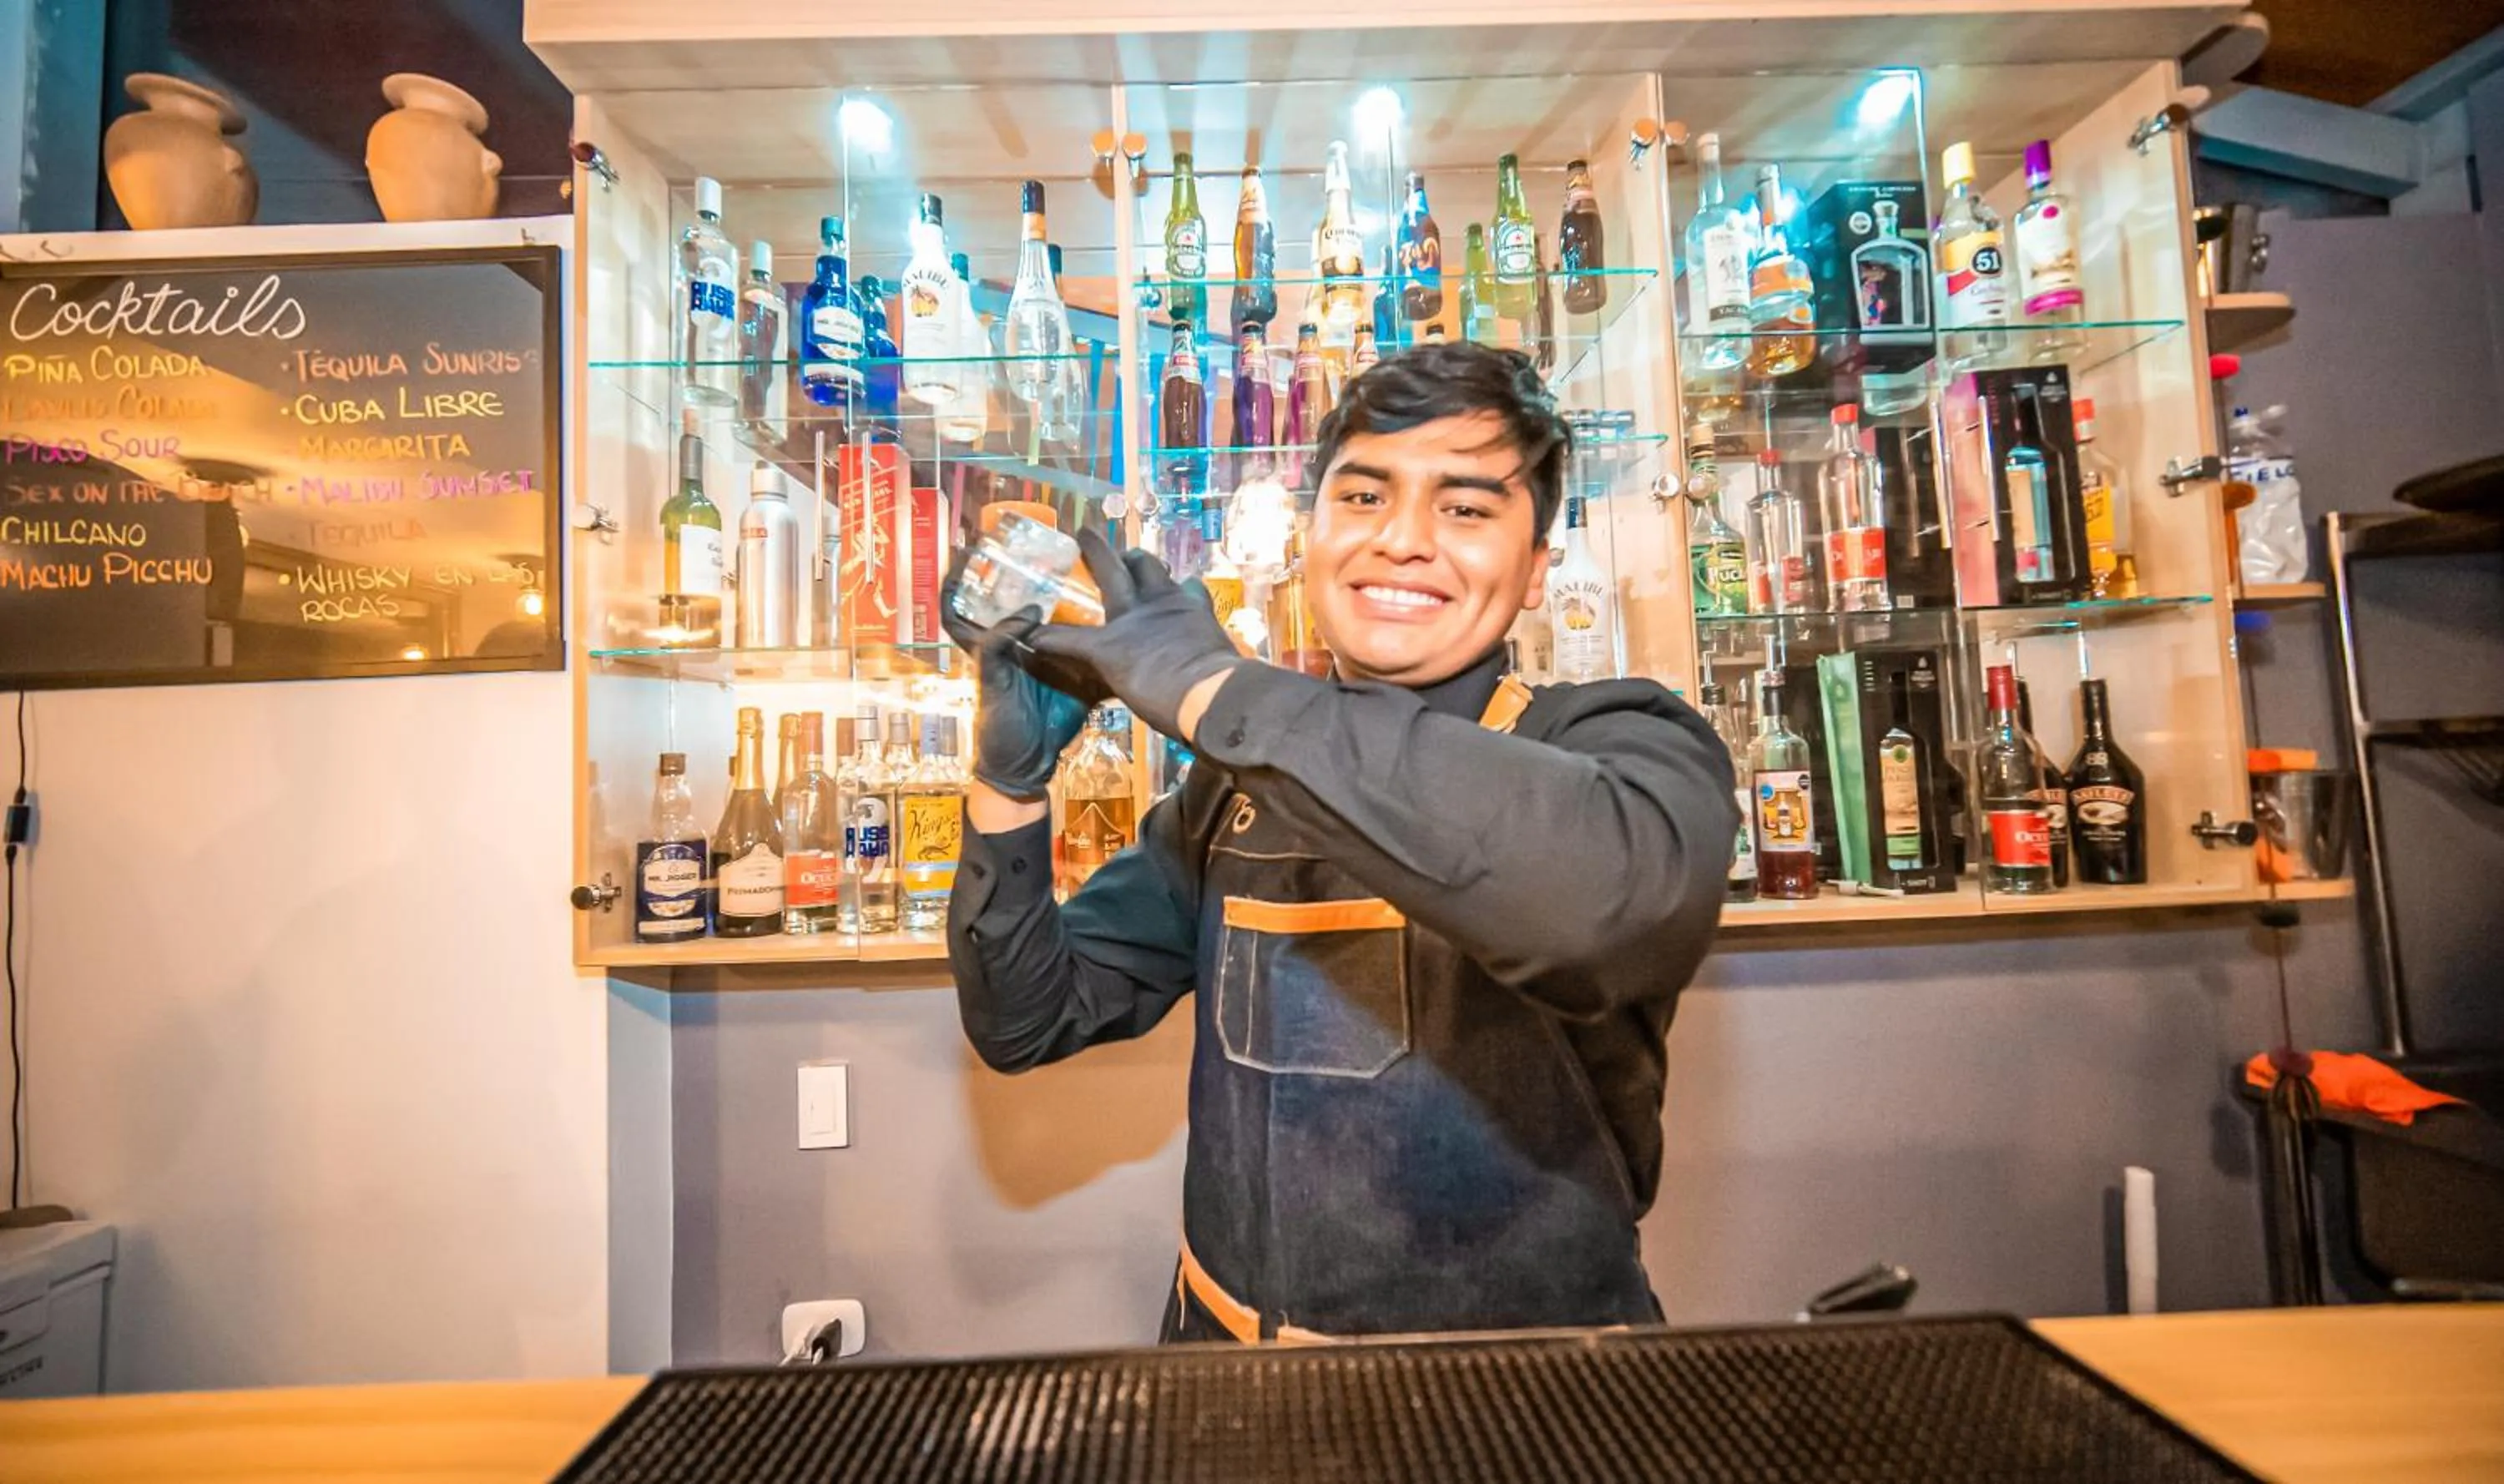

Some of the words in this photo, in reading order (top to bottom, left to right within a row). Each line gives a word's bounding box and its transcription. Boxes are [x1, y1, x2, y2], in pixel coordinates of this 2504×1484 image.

[1976, 250, 2001, 271] 51
[10, 274, 306, 341] Cocktails
[4, 354, 83, 384] PIÑA
[90, 345, 210, 381] COLADA
[295, 394, 386, 426] CUBA
[399, 386, 504, 418] LIBRE
[5, 432, 88, 465] PISCO
[99, 428, 182, 459] SOUR
[300, 433, 471, 461] MARGARITA
[5, 477, 65, 506] SEX
[73, 482, 106, 503] ON
[119, 480, 165, 503] THE
[0, 516, 147, 547] CHILCANO
[307, 518, 429, 548] TEQUILA
[0, 557, 92, 591] MACHU
[103, 552, 213, 585] PICCHU
[296, 563, 412, 595] WHISKY
[434, 565, 474, 585] EN
[300, 593, 401, 623] ROCAS
